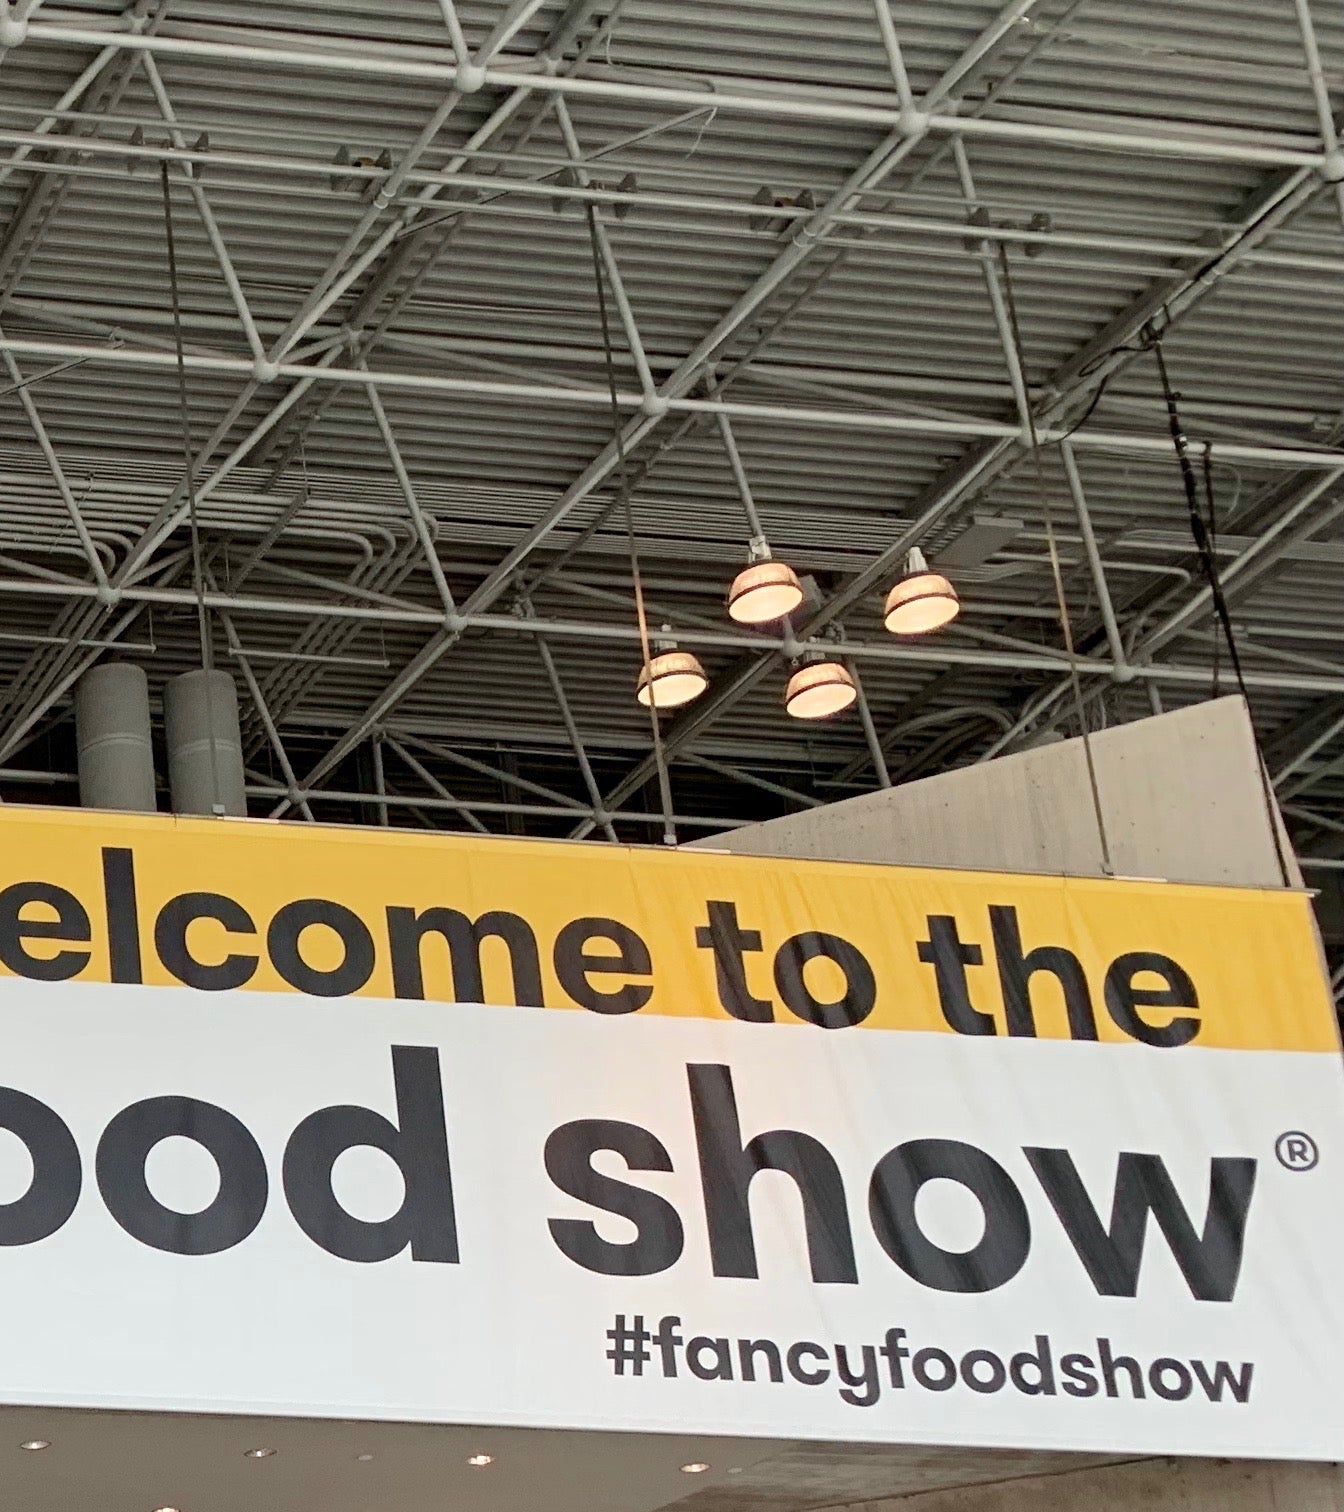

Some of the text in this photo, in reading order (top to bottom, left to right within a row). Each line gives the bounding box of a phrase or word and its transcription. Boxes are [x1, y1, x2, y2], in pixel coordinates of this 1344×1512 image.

[696, 900, 878, 1029] to
[919, 904, 1203, 1048] the
[606, 1312, 1255, 1406] #fancyfoodshow
